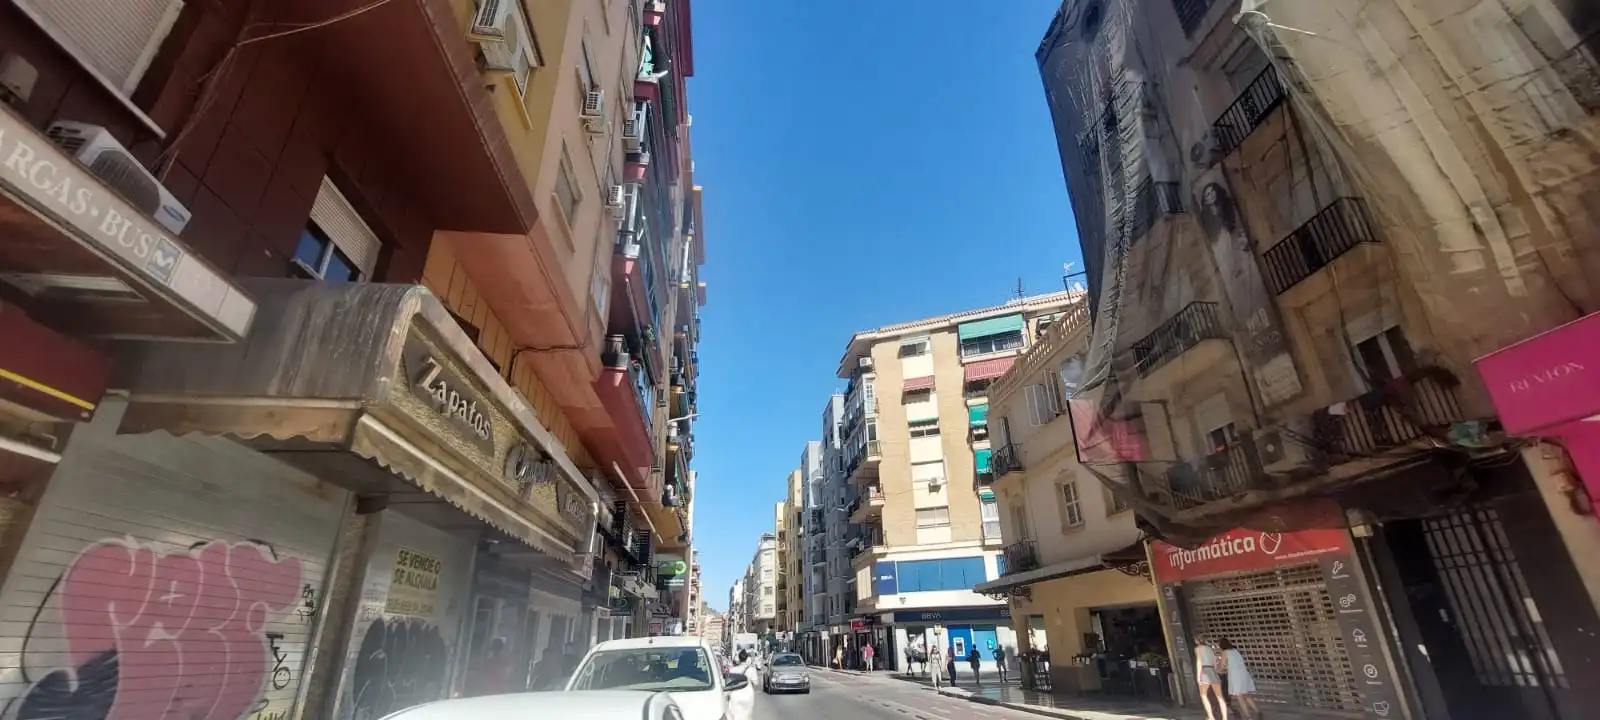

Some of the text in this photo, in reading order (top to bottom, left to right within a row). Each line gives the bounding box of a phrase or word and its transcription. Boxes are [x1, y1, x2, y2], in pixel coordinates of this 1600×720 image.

[1509, 361, 1585, 393] REVLON
[418, 356, 491, 441] Zapatos
[397, 549, 441, 575] SE VENDE O
[1168, 535, 1256, 570] informática
[393, 568, 438, 591] SE ALQUILA
[921, 612, 942, 620] BBVA
